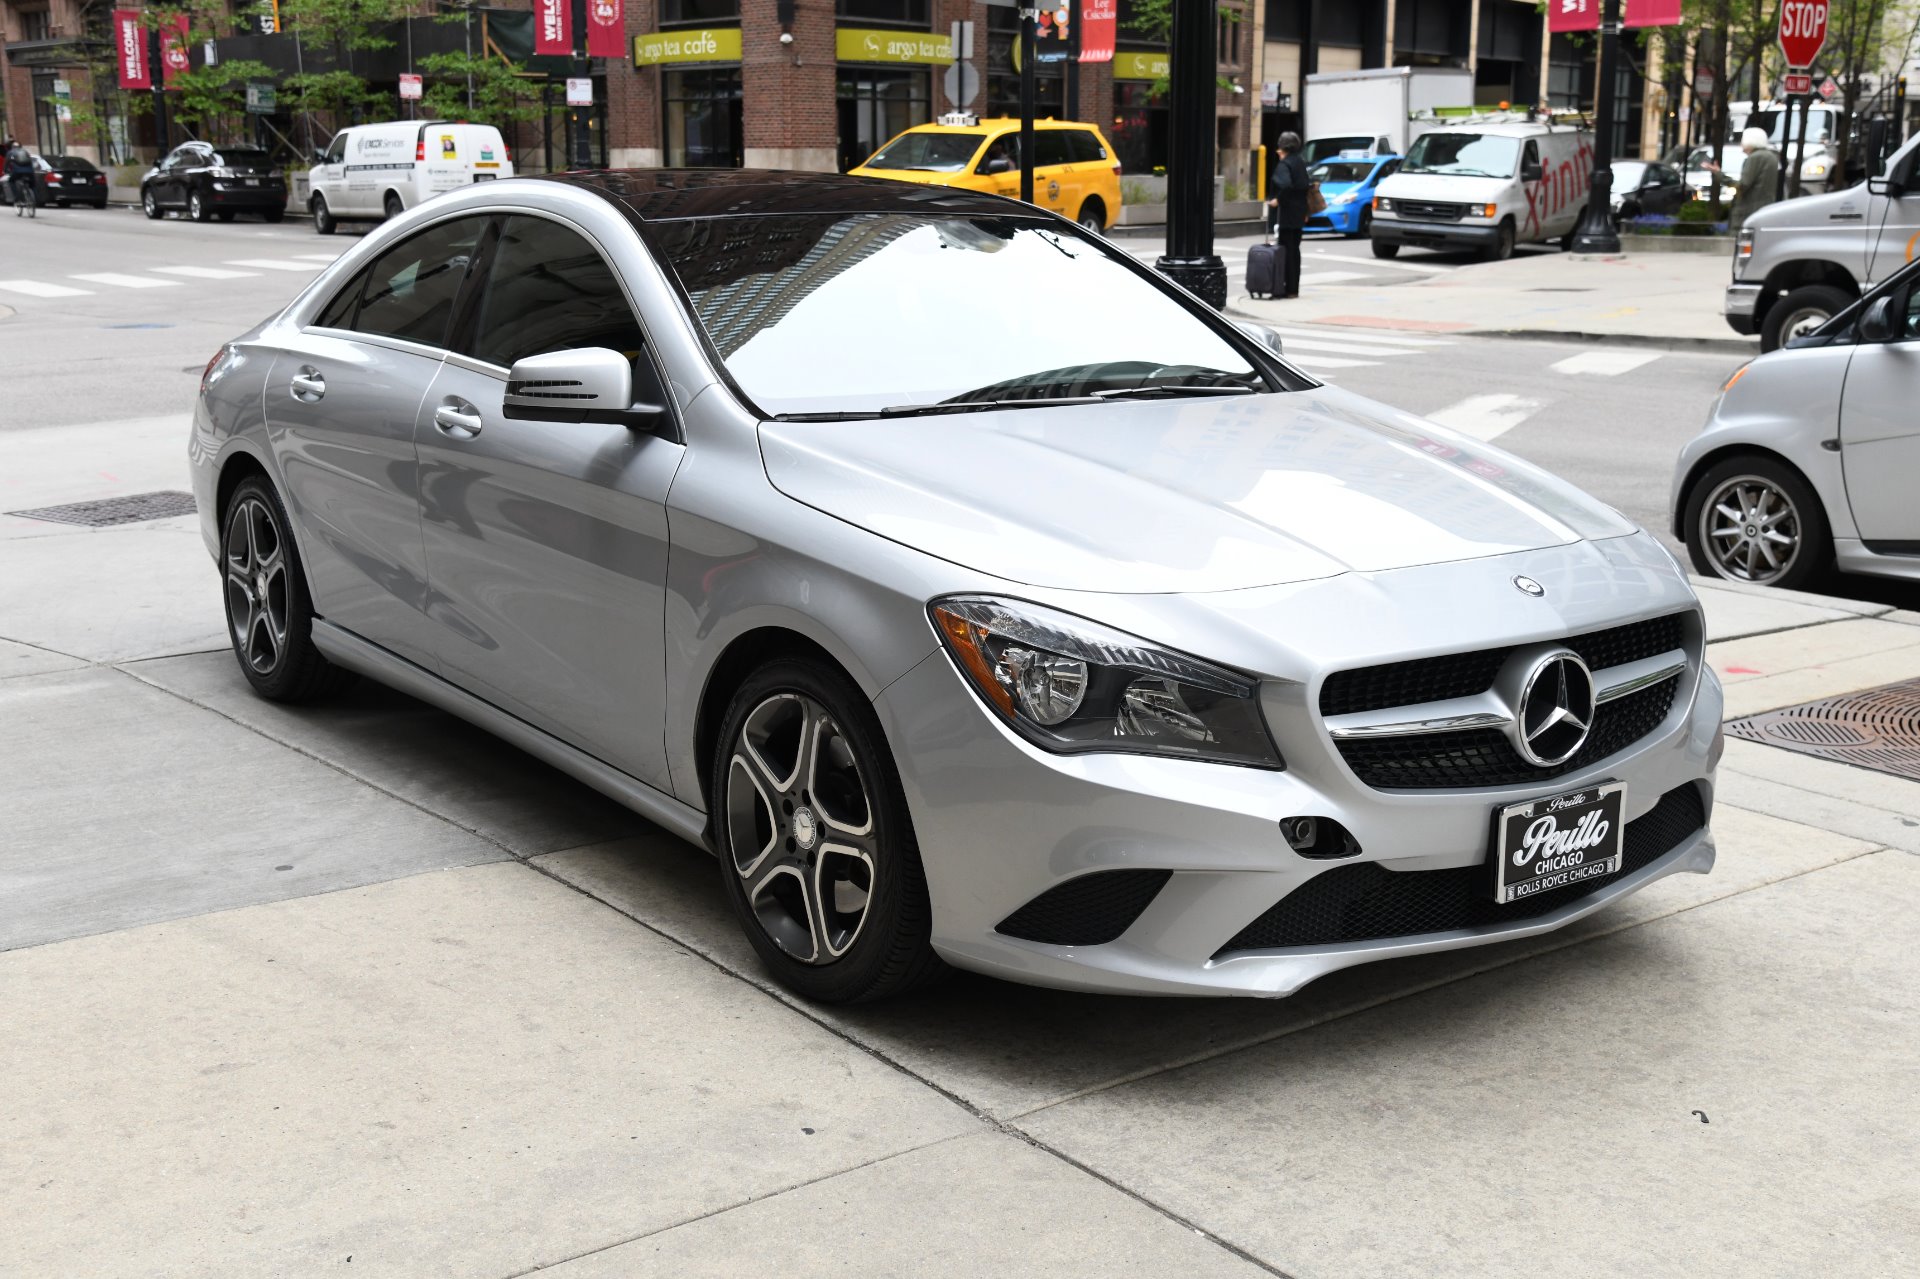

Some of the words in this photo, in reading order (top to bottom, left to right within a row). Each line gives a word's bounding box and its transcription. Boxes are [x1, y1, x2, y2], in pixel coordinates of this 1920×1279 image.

[1782, 2, 1827, 39] STOP
[122, 19, 137, 79] WELCOME
[644, 43, 663, 62] argo
[664, 40, 680, 56] tea
[683, 31, 717, 55] café
[887, 41, 917, 61] argo
[919, 41, 935, 57] tea
[1786, 78, 1797, 90] ALL
[1797, 78, 1809, 90] WAY
[1546, 793, 1586, 812] Perillo
[1513, 809, 1609, 867] Perillo
[1535, 851, 1584, 875] CHICAGO
[1517, 880, 1540, 897] ROLLS
[1542, 872, 1568, 889] ROYCE
[1569, 863, 1605, 882] CHICAGO
